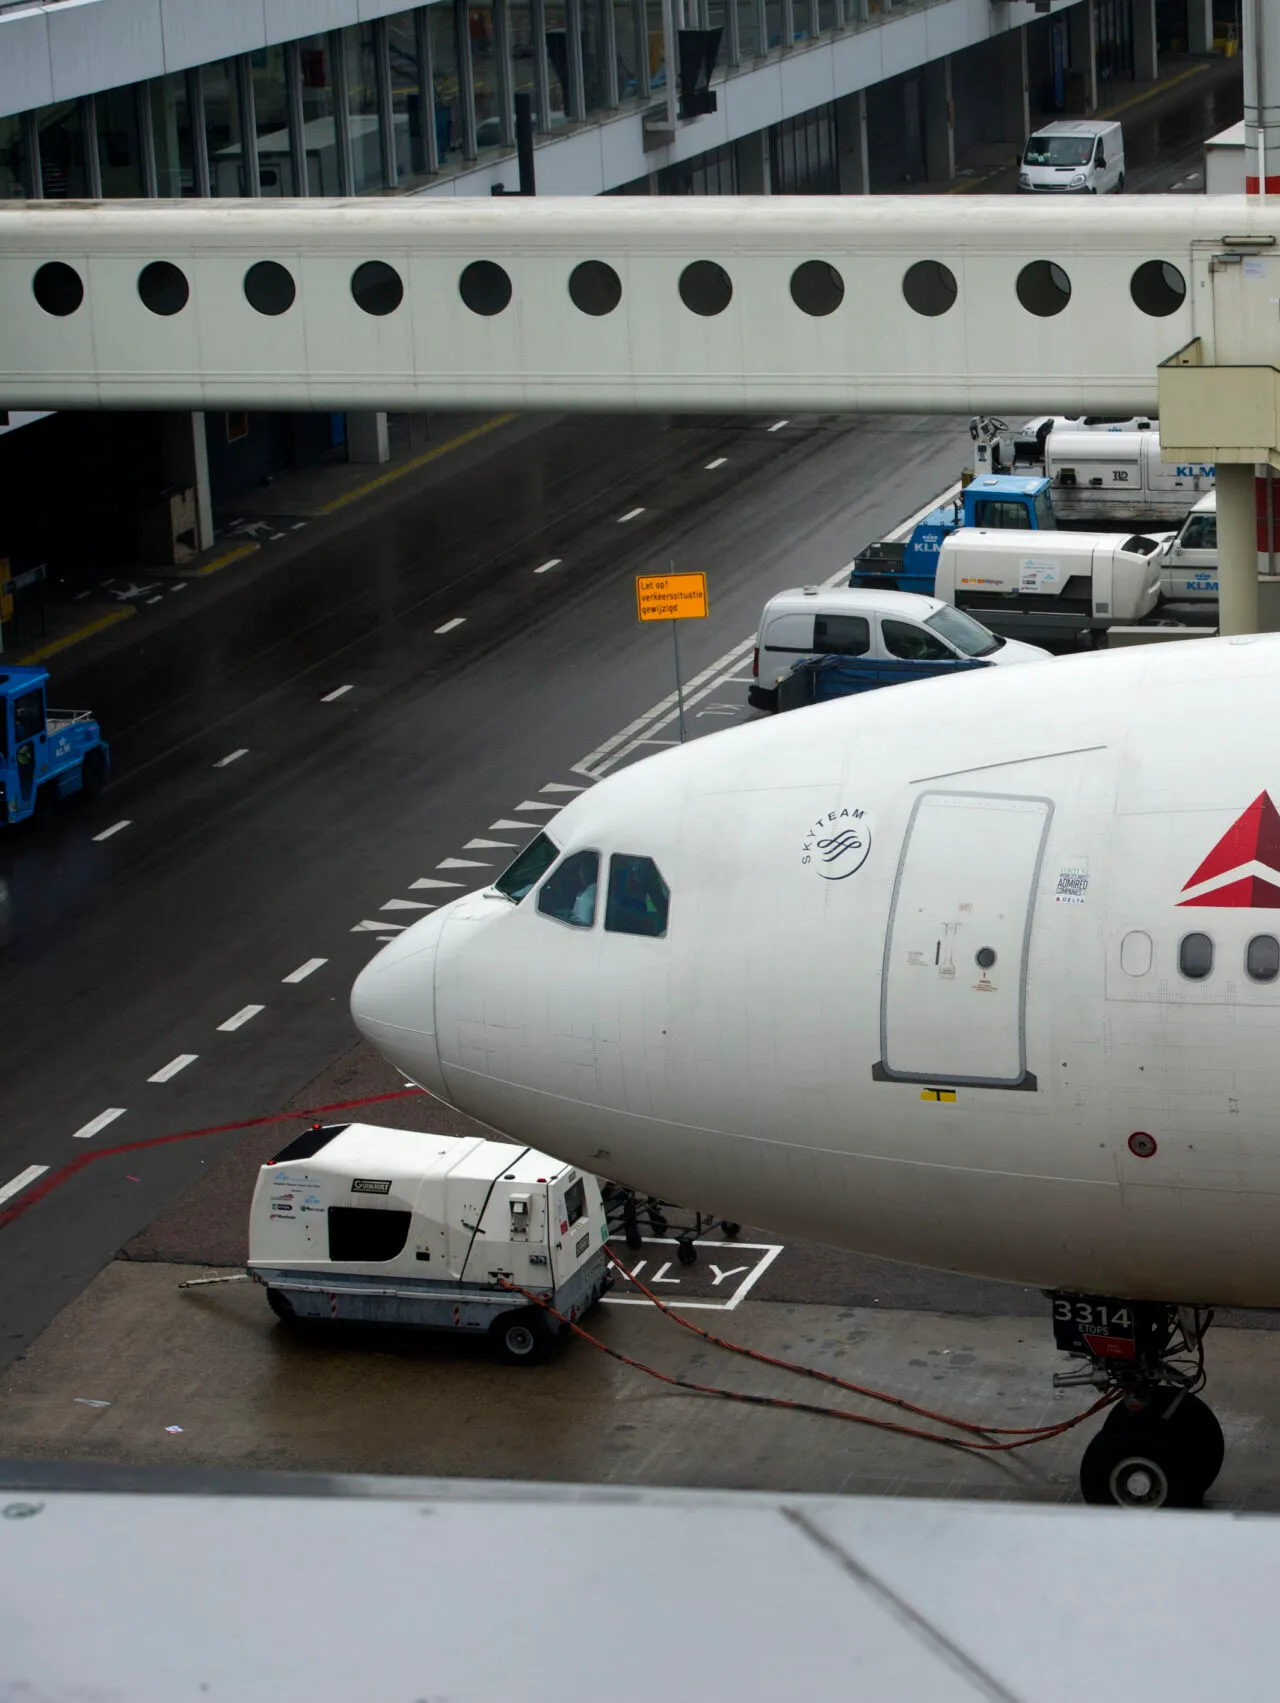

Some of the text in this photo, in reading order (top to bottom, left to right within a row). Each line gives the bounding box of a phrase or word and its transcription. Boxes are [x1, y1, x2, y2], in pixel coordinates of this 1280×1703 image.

[1176, 466, 1216, 478] KLM
[641, 582, 653, 590] Let
[1186, 581, 1219, 591] KLM
[641, 591, 704, 602] verkeerssituatie
[641, 604, 678, 616] gewijzigd
[801, 808, 865, 865] SKYTEAM
[1057, 878, 1089, 890] ADMIRED
[607, 1260, 750, 1286] NLY
[1054, 1300, 1132, 1329] 3314
[1078, 1323, 1109, 1336] ETOPS
